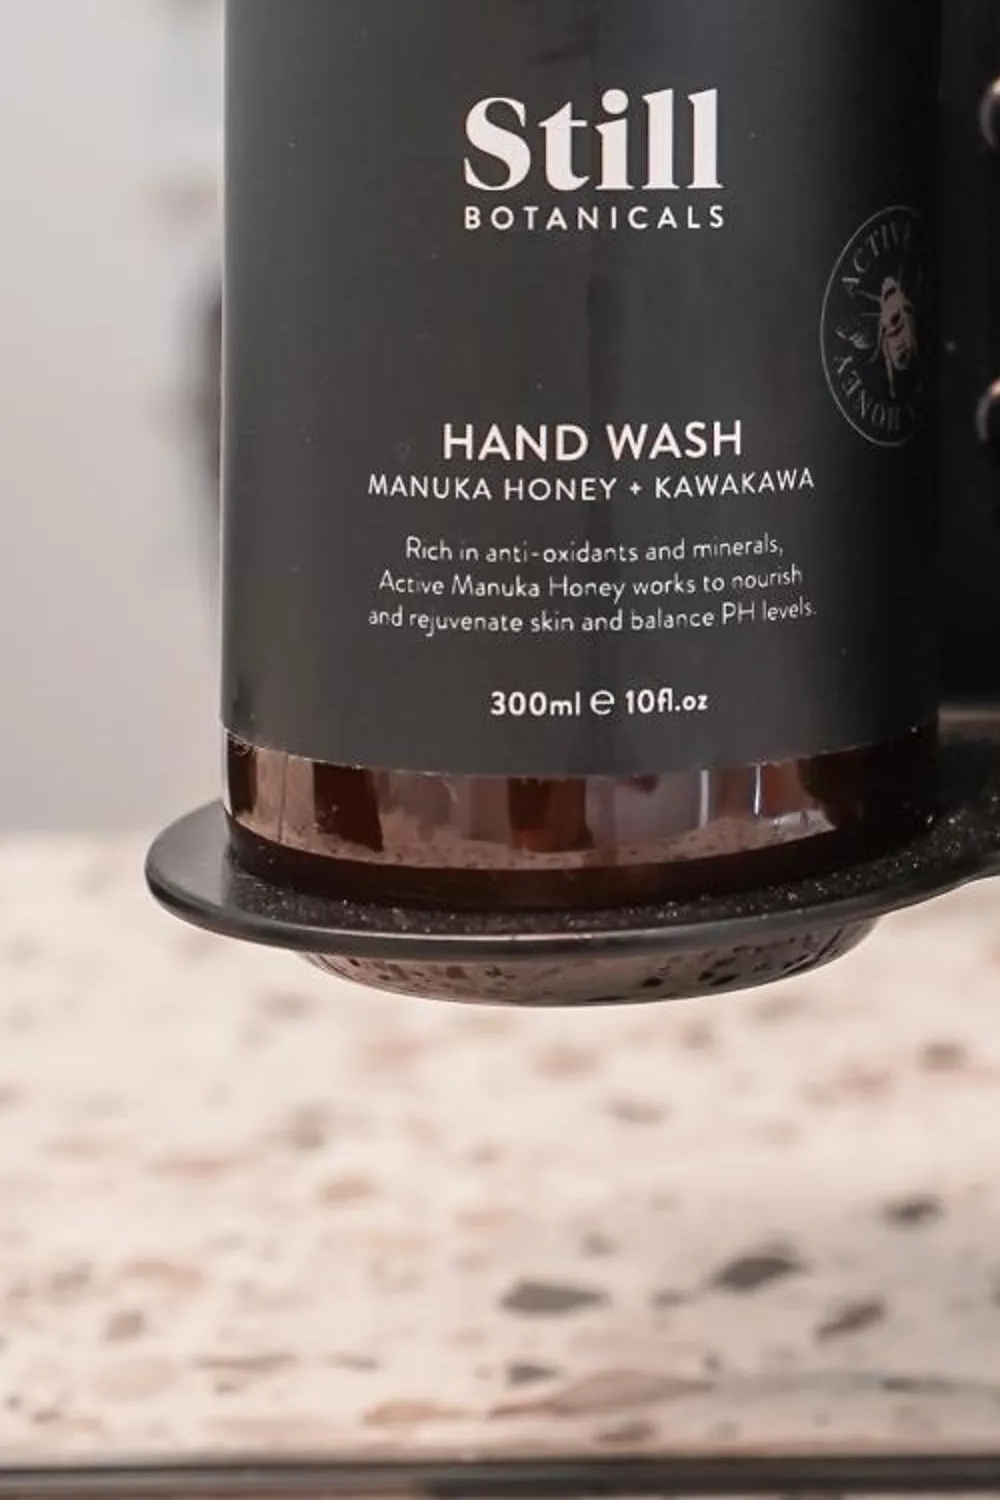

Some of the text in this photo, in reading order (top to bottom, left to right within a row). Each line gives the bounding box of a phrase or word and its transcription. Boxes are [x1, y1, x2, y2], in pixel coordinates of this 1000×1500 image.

[463, 87, 724, 192] Still
[464, 204, 724, 231] BOTANICALS
[443, 419, 742, 462] HAND WASH
[367, 473, 493, 501] MANUKA
[503, 477, 617, 501] HONEY
[655, 467, 815, 499] KAWAKAWA
[405, 532, 784, 564] Rich in anti-oxidants and minerals,
[378, 563, 803, 605] Active Manuka Honey works to nourish
[367, 605, 403, 627] and
[408, 613, 524, 638] rejuvenate
[530, 610, 575, 633] skin
[581, 608, 624, 632] and
[630, 607, 715, 631] balance
[721, 601, 755, 625] PH
[490, 690, 581, 717] 300ml
[625, 687, 709, 715] 10fl.oz
